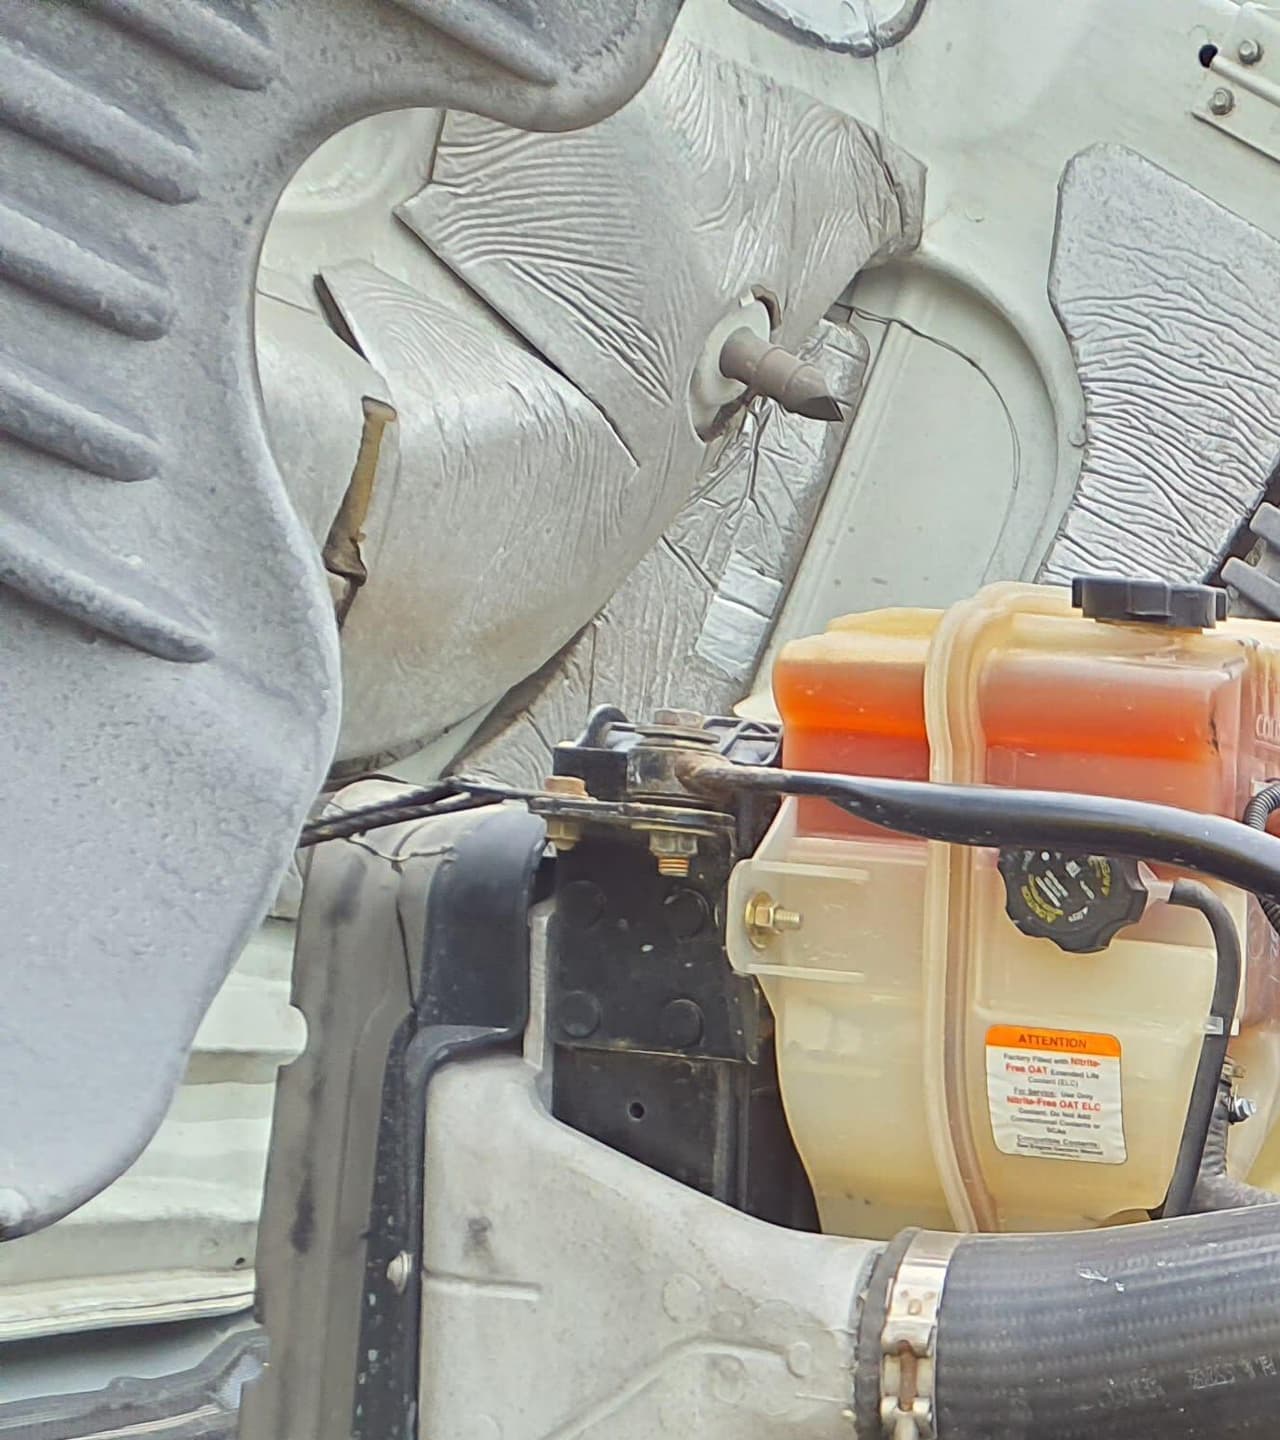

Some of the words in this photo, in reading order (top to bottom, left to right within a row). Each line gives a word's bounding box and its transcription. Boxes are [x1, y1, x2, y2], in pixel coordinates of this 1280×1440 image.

[1018, 1034, 1087, 1048] ATTENTION
[1005, 1062, 1026, 1073] Free
[1027, 1065, 1048, 1075] OAT
[1059, 1098, 1079, 1109] OAT
[1082, 1101, 1101, 1111] ELC
